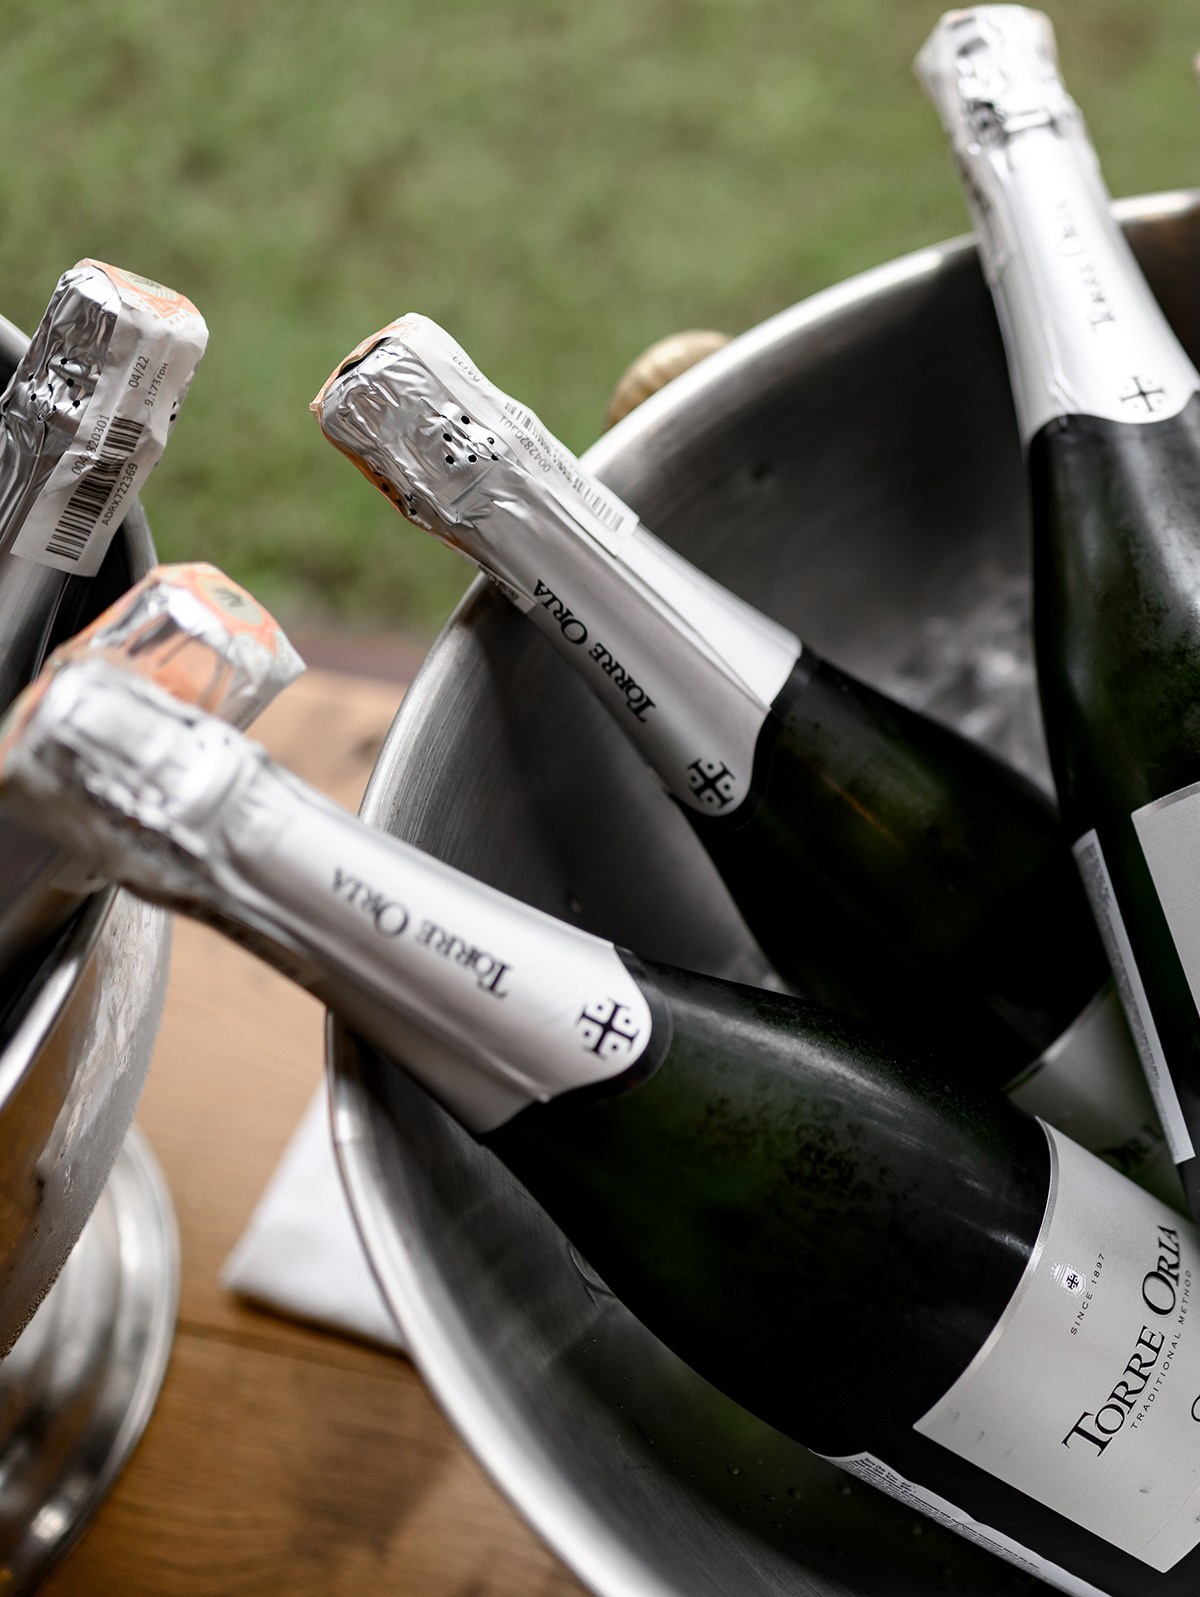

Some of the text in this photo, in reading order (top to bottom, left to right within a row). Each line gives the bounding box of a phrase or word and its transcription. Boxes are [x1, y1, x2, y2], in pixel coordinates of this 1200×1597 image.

[128, 355, 151, 389] 04/22
[533, 579, 657, 723] TORRE ORIA
[333, 867, 512, 998] TORRE ORIA
[1061, 1225, 1180, 1457] TORRE ORIA
[1070, 1253, 1105, 1335] SINCE 1897
[1130, 1270, 1193, 1430] TRADITIONAL METHOD
